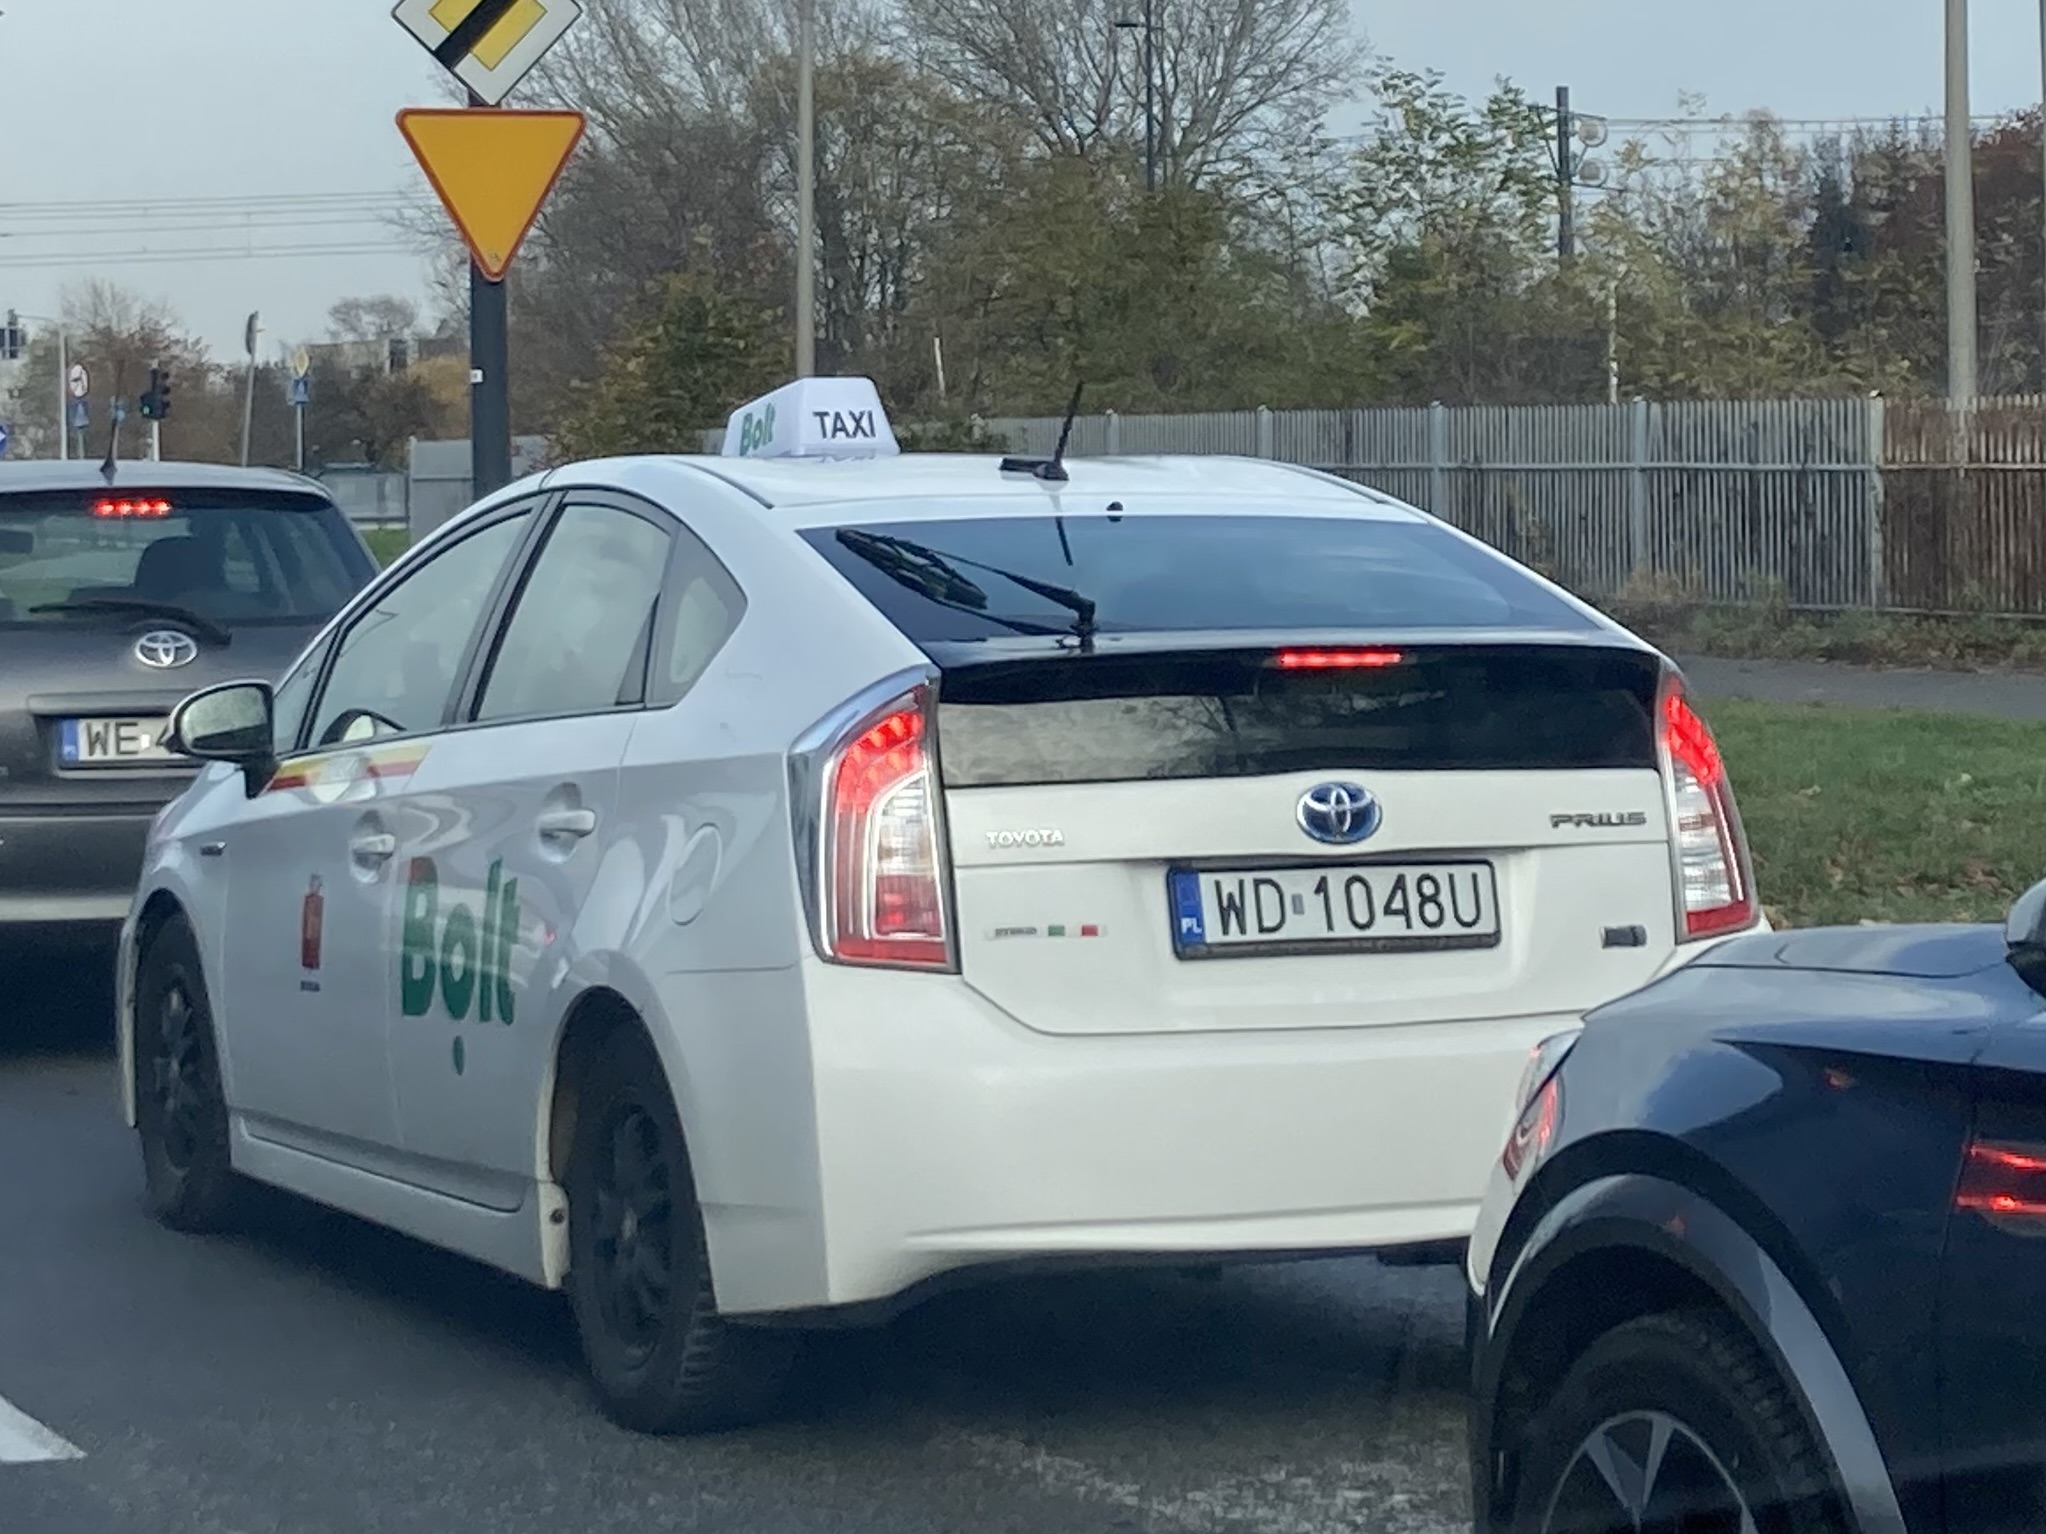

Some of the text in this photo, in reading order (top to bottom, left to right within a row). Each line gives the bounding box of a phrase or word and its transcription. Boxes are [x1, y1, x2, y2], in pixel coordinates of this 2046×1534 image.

[739, 402, 776, 456] Bolt
[812, 409, 877, 439] TAXI
[85, 721, 140, 757] WE
[1549, 811, 1648, 829] PRIUS
[985, 829, 1065, 848] TOYOTA
[1213, 871, 1482, 936] WD 1048U
[401, 855, 521, 1027] Bolt
[1180, 917, 1203, 934] PL
